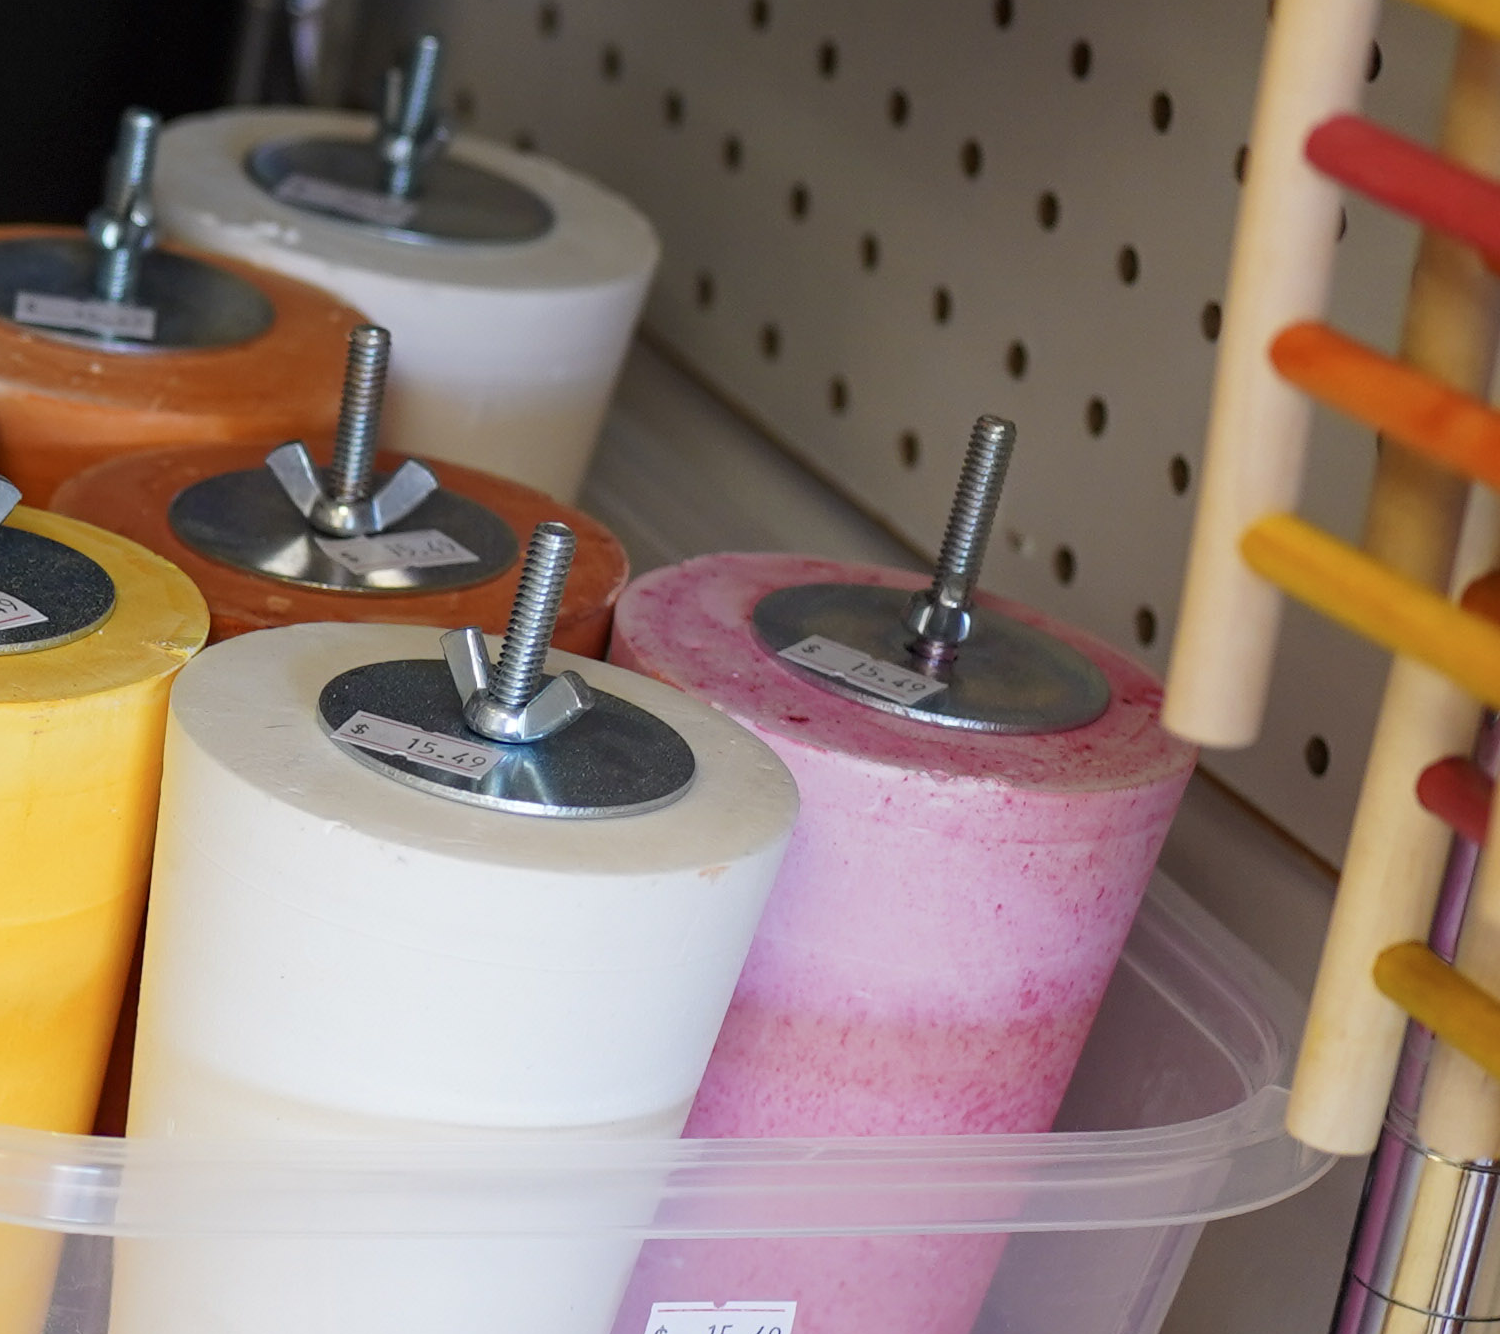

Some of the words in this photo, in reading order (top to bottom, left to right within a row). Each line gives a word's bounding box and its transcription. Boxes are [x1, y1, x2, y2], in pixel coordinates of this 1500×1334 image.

[852, 662, 926, 692] 15.49
[350, 723, 369, 735] $
[406, 738, 486, 768] 15.49
